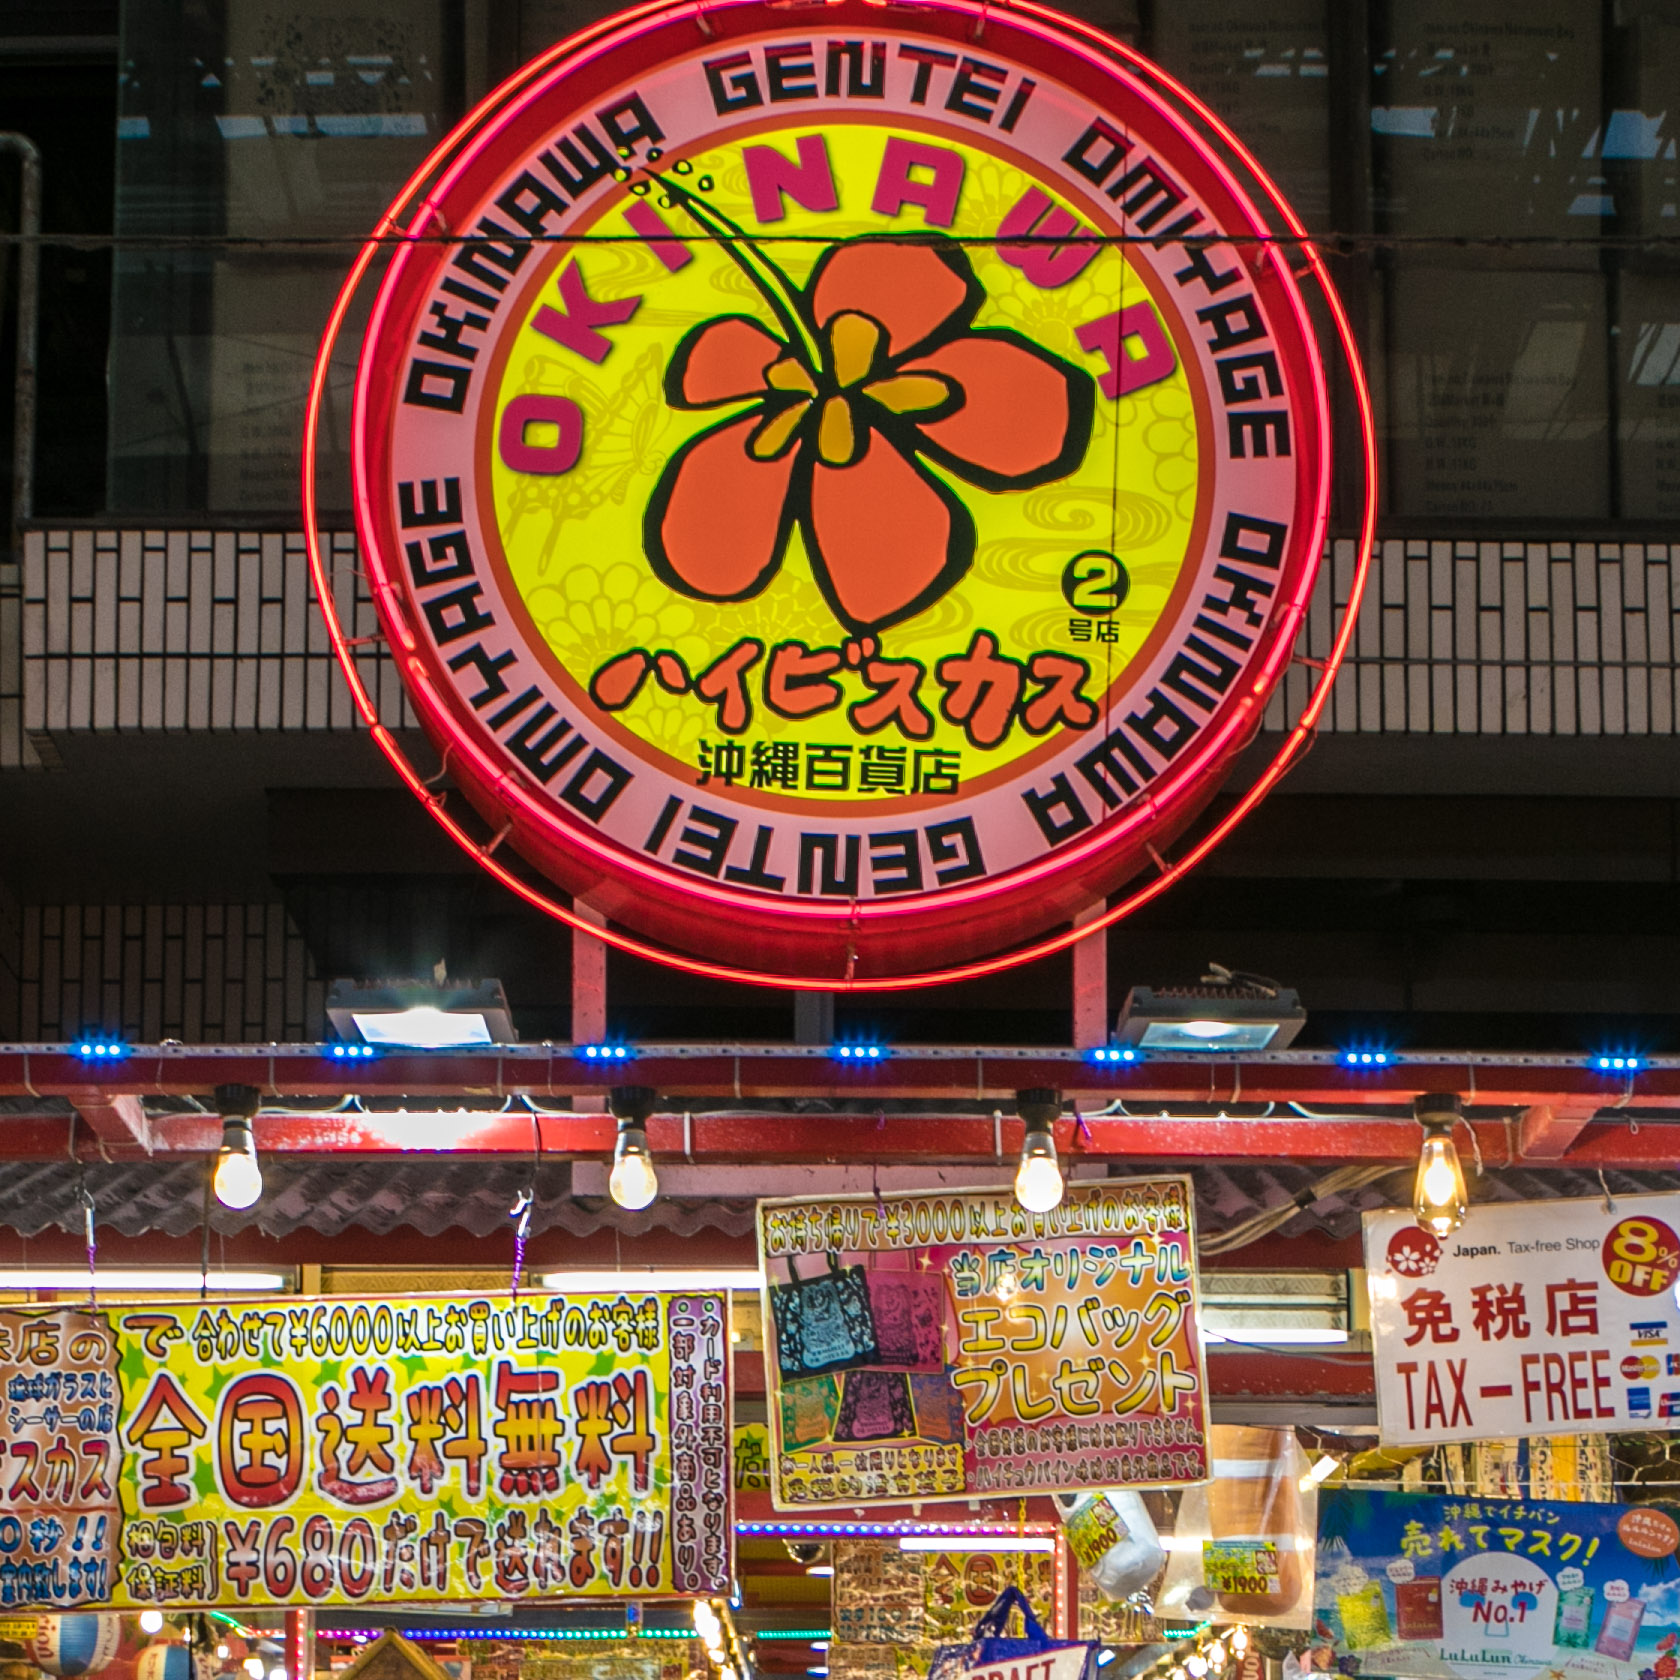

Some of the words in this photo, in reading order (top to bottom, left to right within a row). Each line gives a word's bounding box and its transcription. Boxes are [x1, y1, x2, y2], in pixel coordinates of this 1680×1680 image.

[403, 92, 665, 413] OKINAWA
[703, 40, 1036, 132] GENTEI
[1061, 119, 1291, 460] OMIYAGE
[498, 134, 1177, 476] OKINAWA
[398, 476, 635, 823] OMIYAGE
[1068, 617, 1120, 643] 号店
[590, 631, 1098, 749] ハイビスカス
[1019, 512, 1288, 848] OKINAWA
[697, 739, 961, 796] 沖縄百貨店
[644, 798, 989, 897] GENTEI
[951, 1241, 1191, 1297] 当店オリジナル
[1452, 1243, 1501, 1258] Japan.
[1508, 1239, 1562, 1255] Tax-free
[1565, 1237, 1600, 1252] Shop
[1609, 1259, 1670, 1292] OFF
[961, 1291, 1191, 1353] エコバッグ
[1400, 1278, 1600, 1348] 免税店
[1636, 1329, 1662, 1339] VISA
[8, 1372, 112, 1401] 琉球ガラスと
[953, 1352, 1197, 1424] プレゼント
[1396, 1350, 1616, 1431] TAX-FREE
[8, 1402, 112, 1434] シーサーの店
[125, 1360, 657, 1509] 全国送料無料
[1443, 1504, 1561, 1524] 沖縄でイチバン
[223, 1506, 664, 1599] ¥680だけで送れます!!
[1222, 1576, 1267, 1592] ¥1900
[1449, 1578, 1549, 1596] 沖縄みやげ
[1472, 1600, 1529, 1624] No.1
